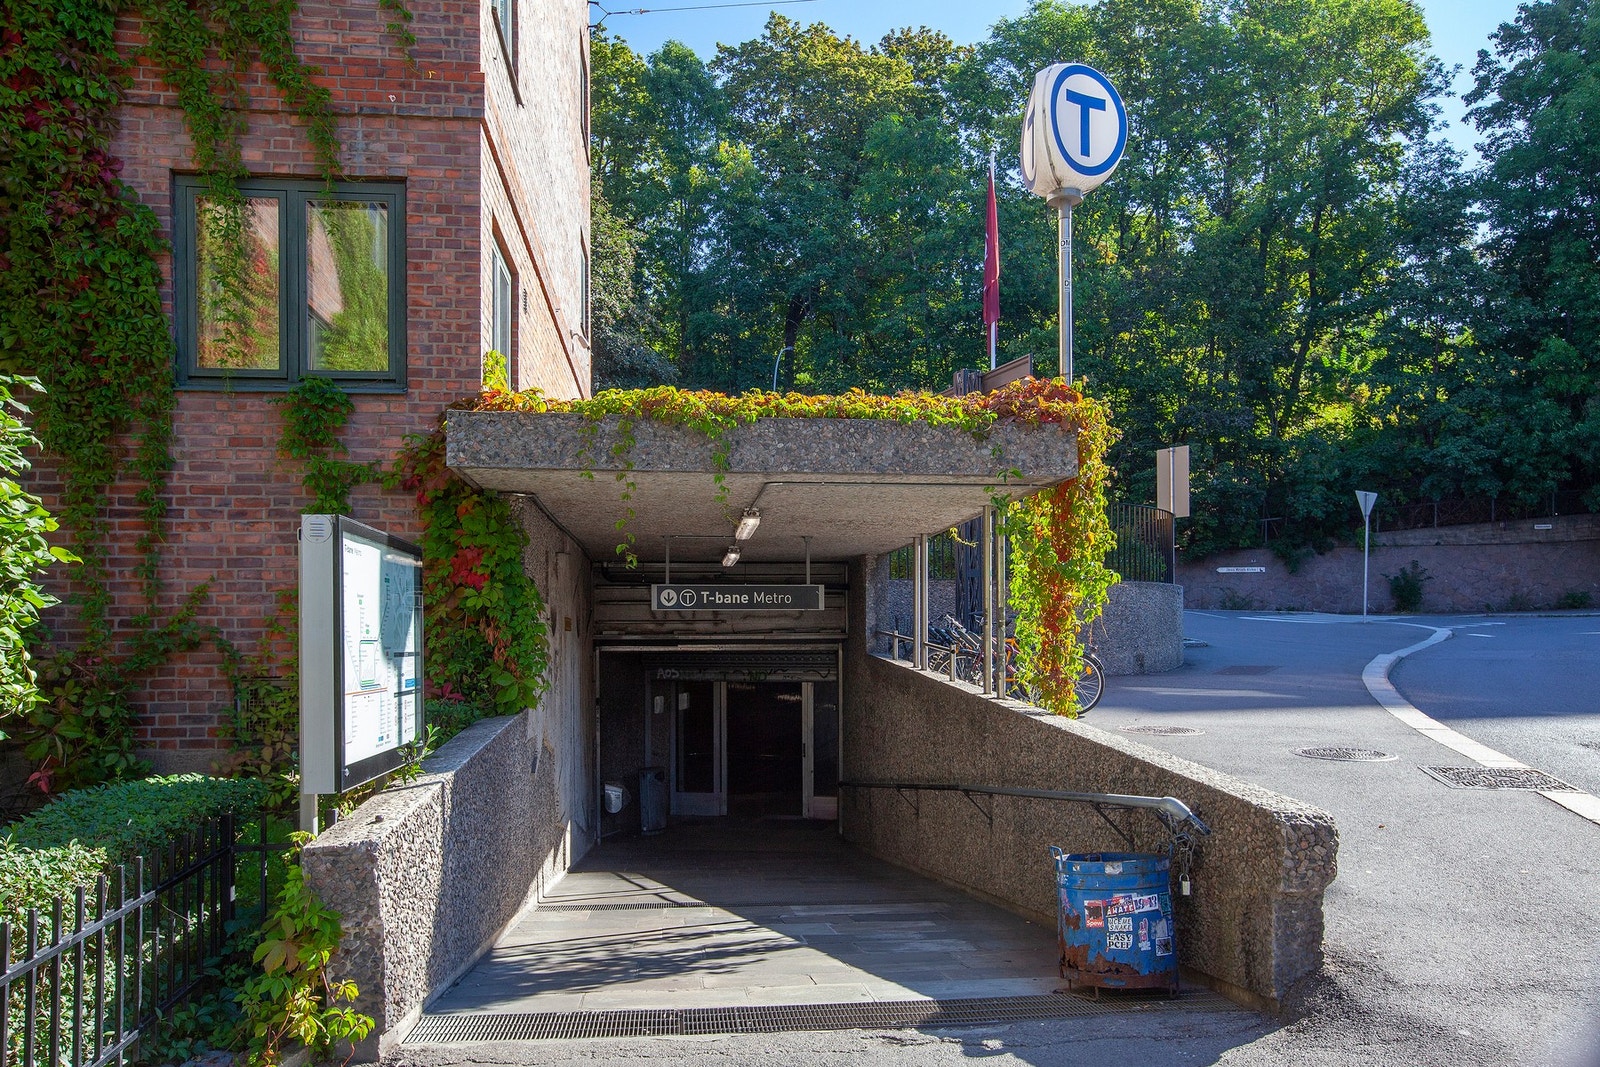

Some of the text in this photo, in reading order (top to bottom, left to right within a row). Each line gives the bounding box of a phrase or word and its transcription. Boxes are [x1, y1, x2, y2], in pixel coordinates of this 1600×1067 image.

[1066, 88, 1106, 158] T
[701, 591, 749, 604] T-bane
[753, 591, 792, 604] Metro
